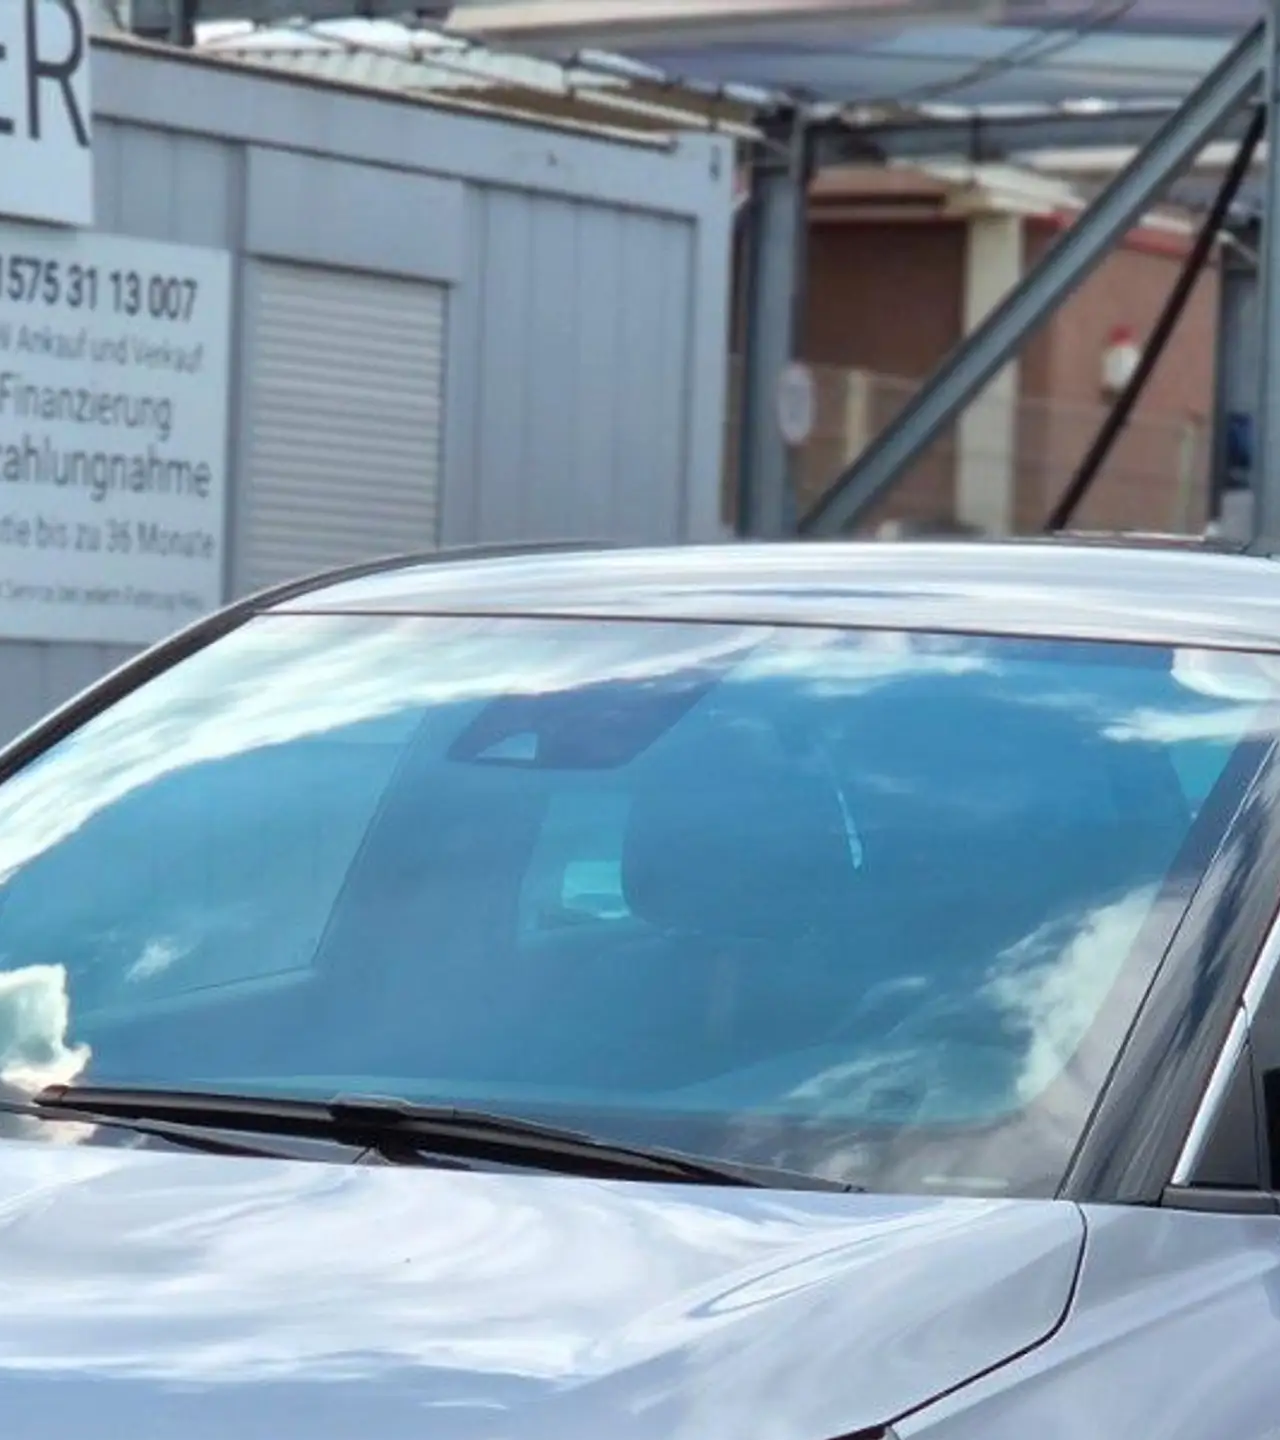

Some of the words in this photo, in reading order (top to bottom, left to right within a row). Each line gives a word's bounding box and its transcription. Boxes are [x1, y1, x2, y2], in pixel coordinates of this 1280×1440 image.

[67, 264, 100, 312] 31
[109, 269, 141, 317] 13
[148, 273, 199, 323] 007
[16, 323, 88, 362] Ankauf
[90, 334, 128, 366] und
[131, 334, 204, 375] Verkauf
[35, 514, 69, 551] bis
[75, 523, 102, 553] zu
[137, 521, 216, 559] Monate
